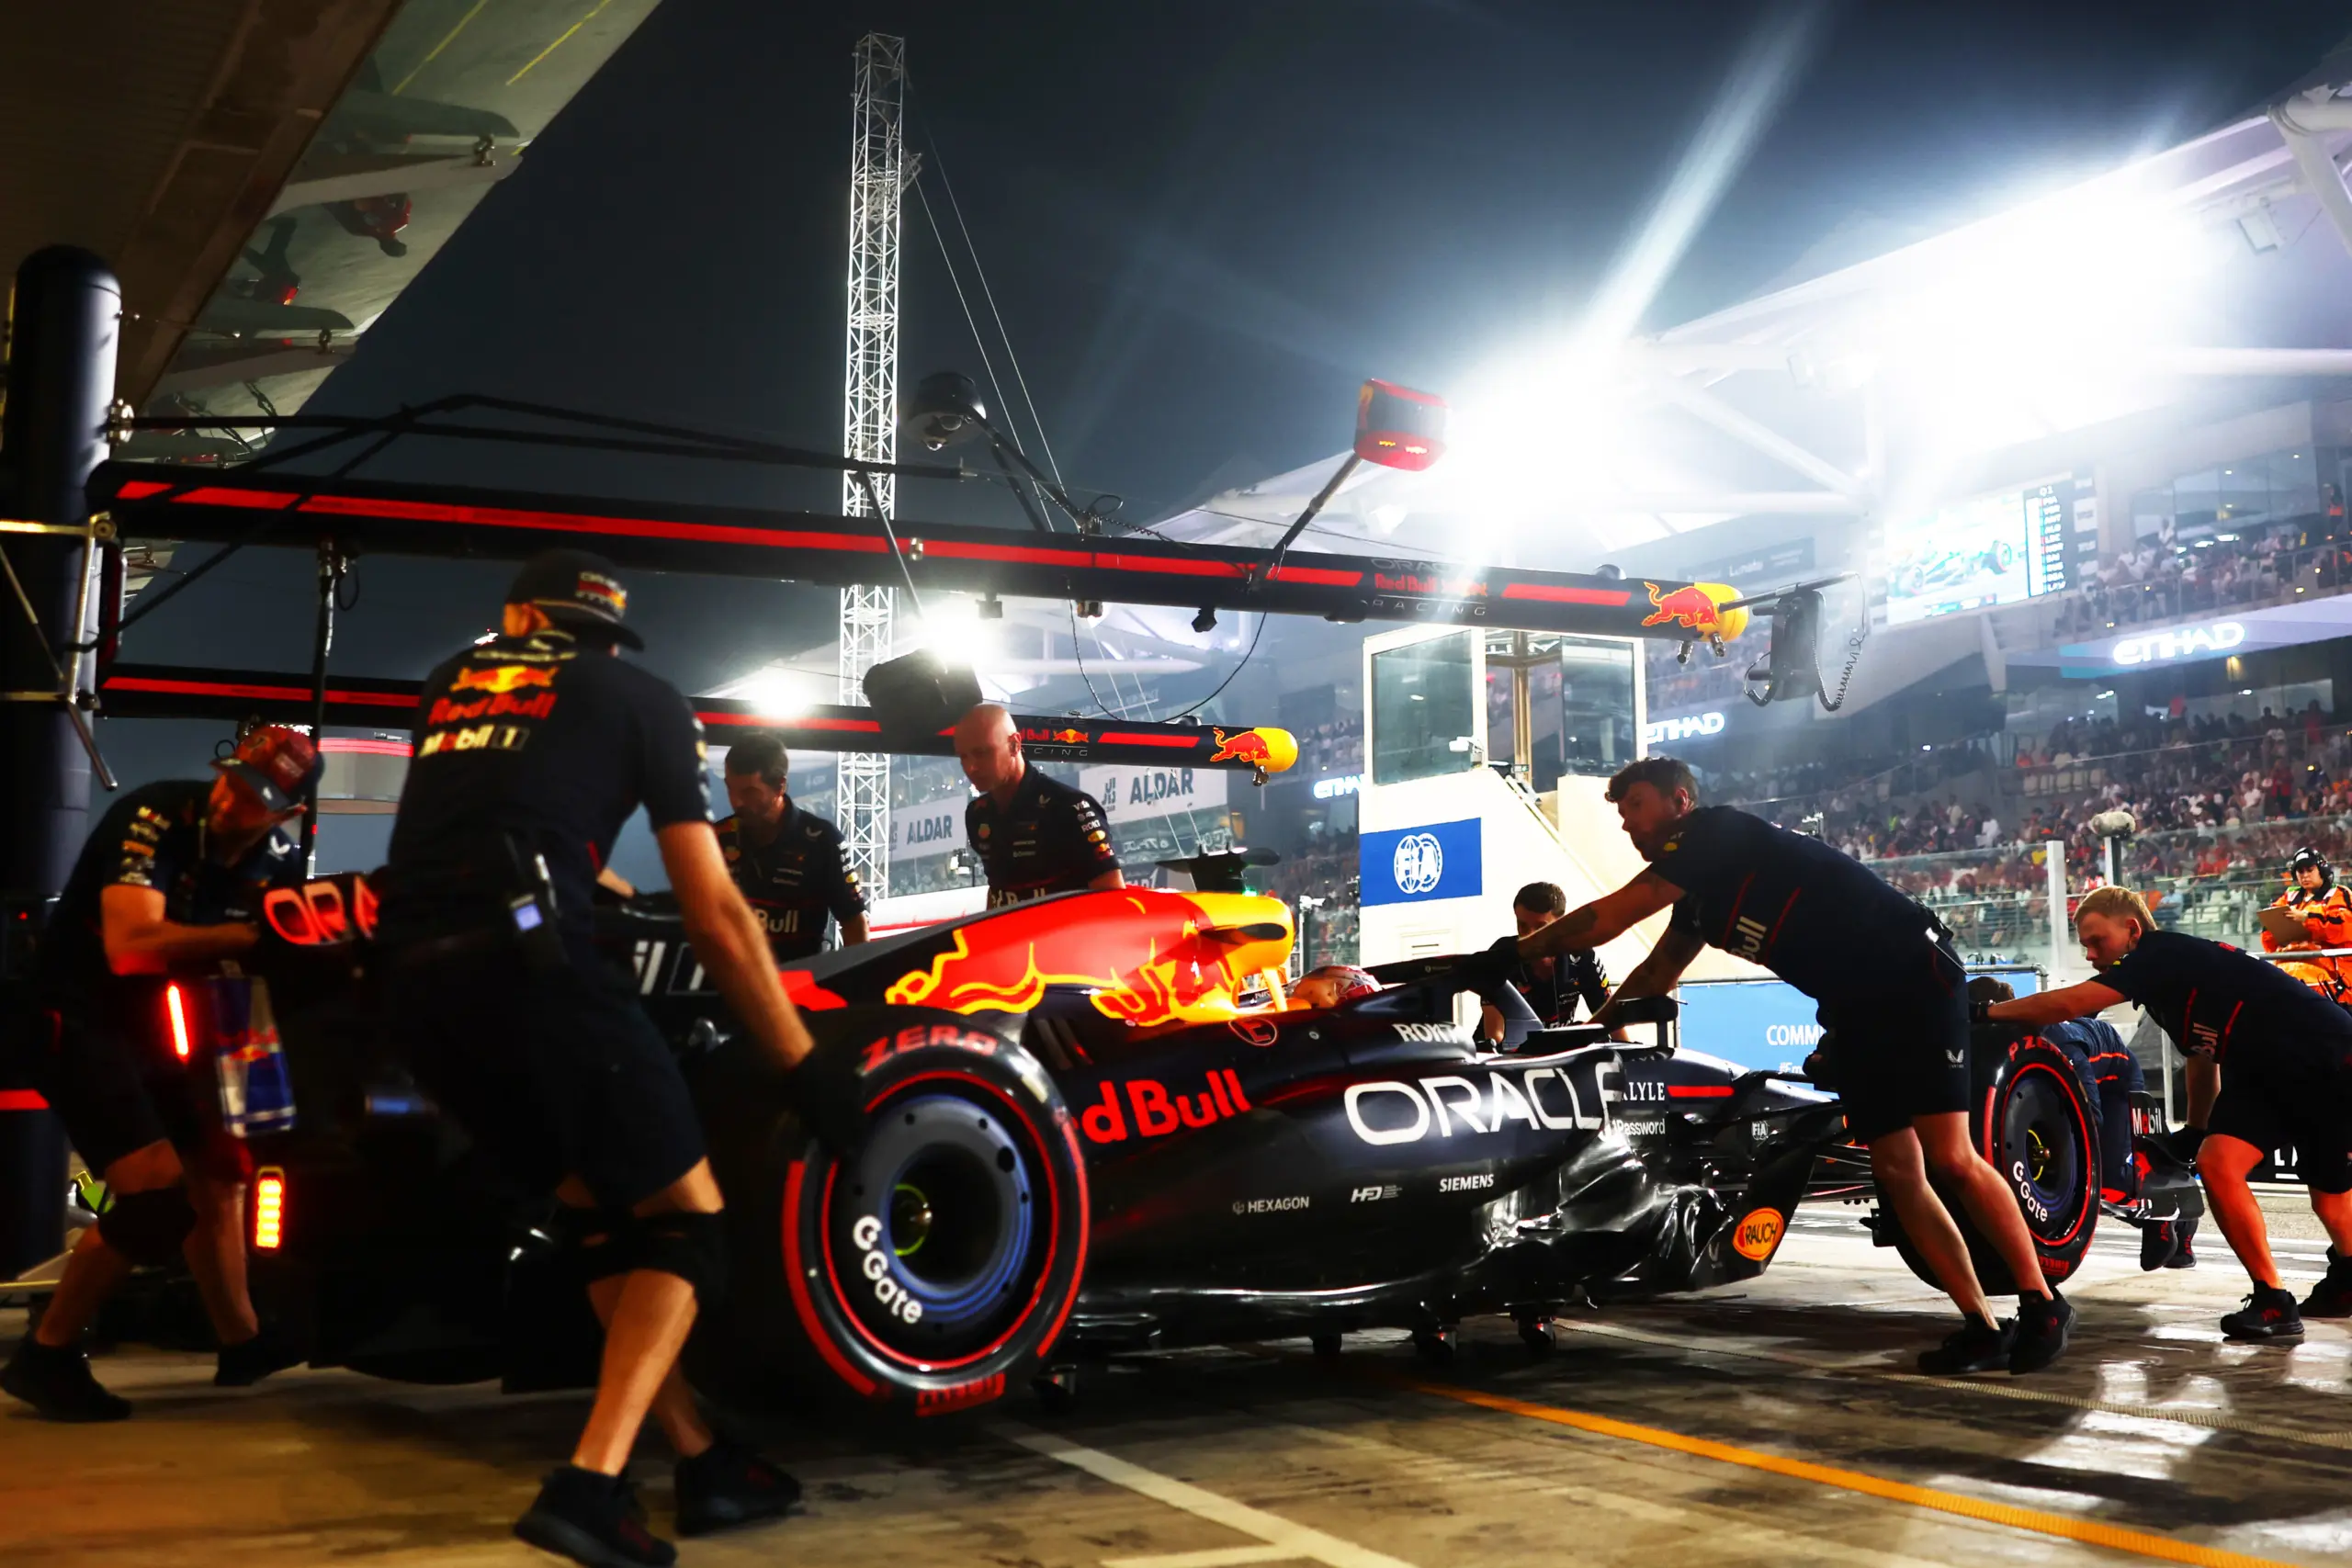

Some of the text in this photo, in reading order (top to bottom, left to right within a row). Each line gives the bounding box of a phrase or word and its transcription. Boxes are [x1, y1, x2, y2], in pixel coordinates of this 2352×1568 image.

[1374, 572, 1439, 592] Red Bull
[1373, 599, 1487, 615] RACING
[2113, 622, 2245, 665] ETIHAD
[429, 693, 558, 725] Red Bull
[1129, 768, 1194, 805] ALDAR
[1314, 774, 1365, 799] ETIHA
[906, 815, 953, 844] ALDAR
[1397, 844, 1437, 878] FIA
[1393, 1022, 1459, 1043] ROKT
[1766, 1024, 1826, 1046] COMM
[861, 1024, 999, 1072] ZERO
[1125, 1068, 1252, 1137] Bull
[1343, 1062, 1625, 1146] ORACLE
[1623, 1082, 1666, 1101] LYLE
[2132, 1108, 2163, 1135] Mobil
[1439, 1174, 1495, 1192] SIEMENS
[1248, 1196, 1310, 1213] HEXAGON
[1746, 1222, 1778, 1246] RAUCH
[863, 1250, 922, 1324] Gate
